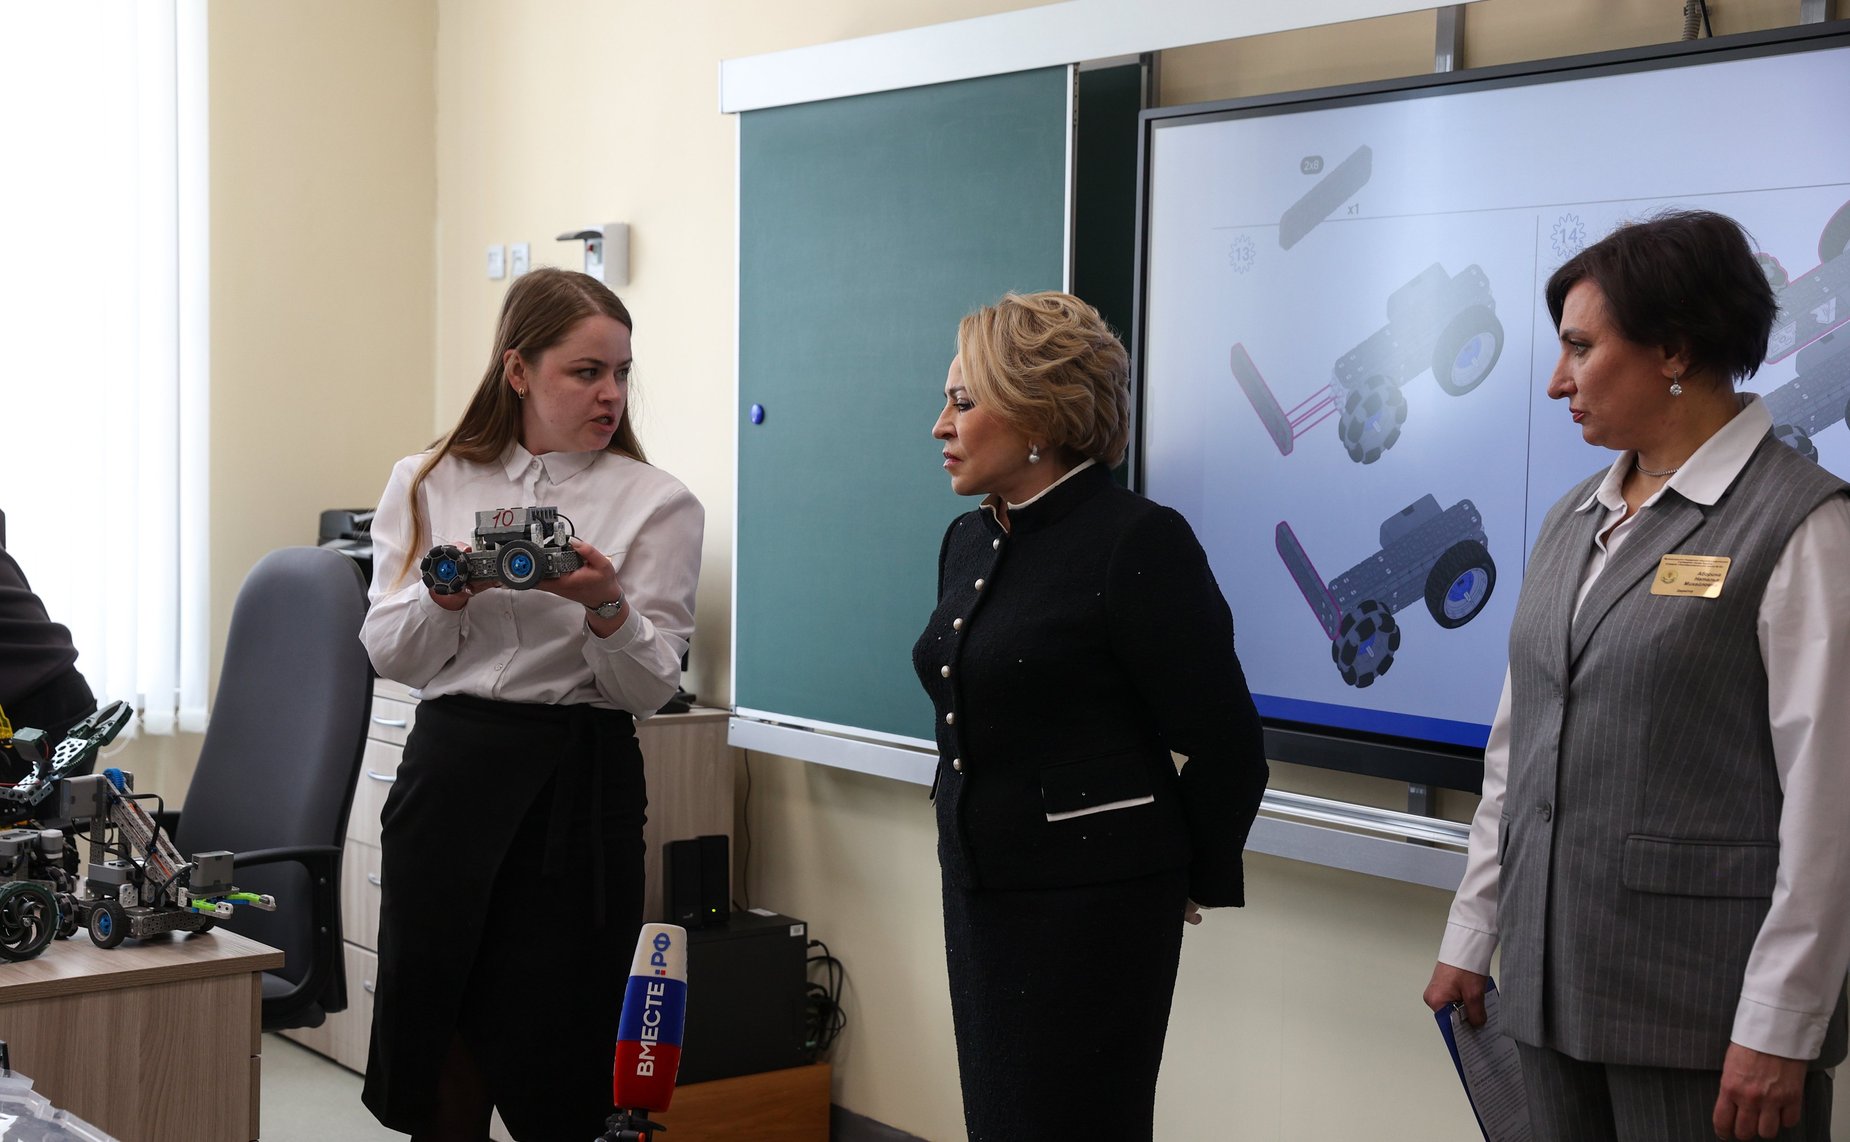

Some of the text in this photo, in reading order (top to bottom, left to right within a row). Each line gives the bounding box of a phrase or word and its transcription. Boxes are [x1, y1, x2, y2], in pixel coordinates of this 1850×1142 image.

[1347, 203, 1360, 215] x1
[1559, 227, 1578, 243] 14
[1235, 246, 1250, 262] 13
[492, 509, 515, 529] 10
[636, 981, 665, 1077] ВМЕСТЕ
